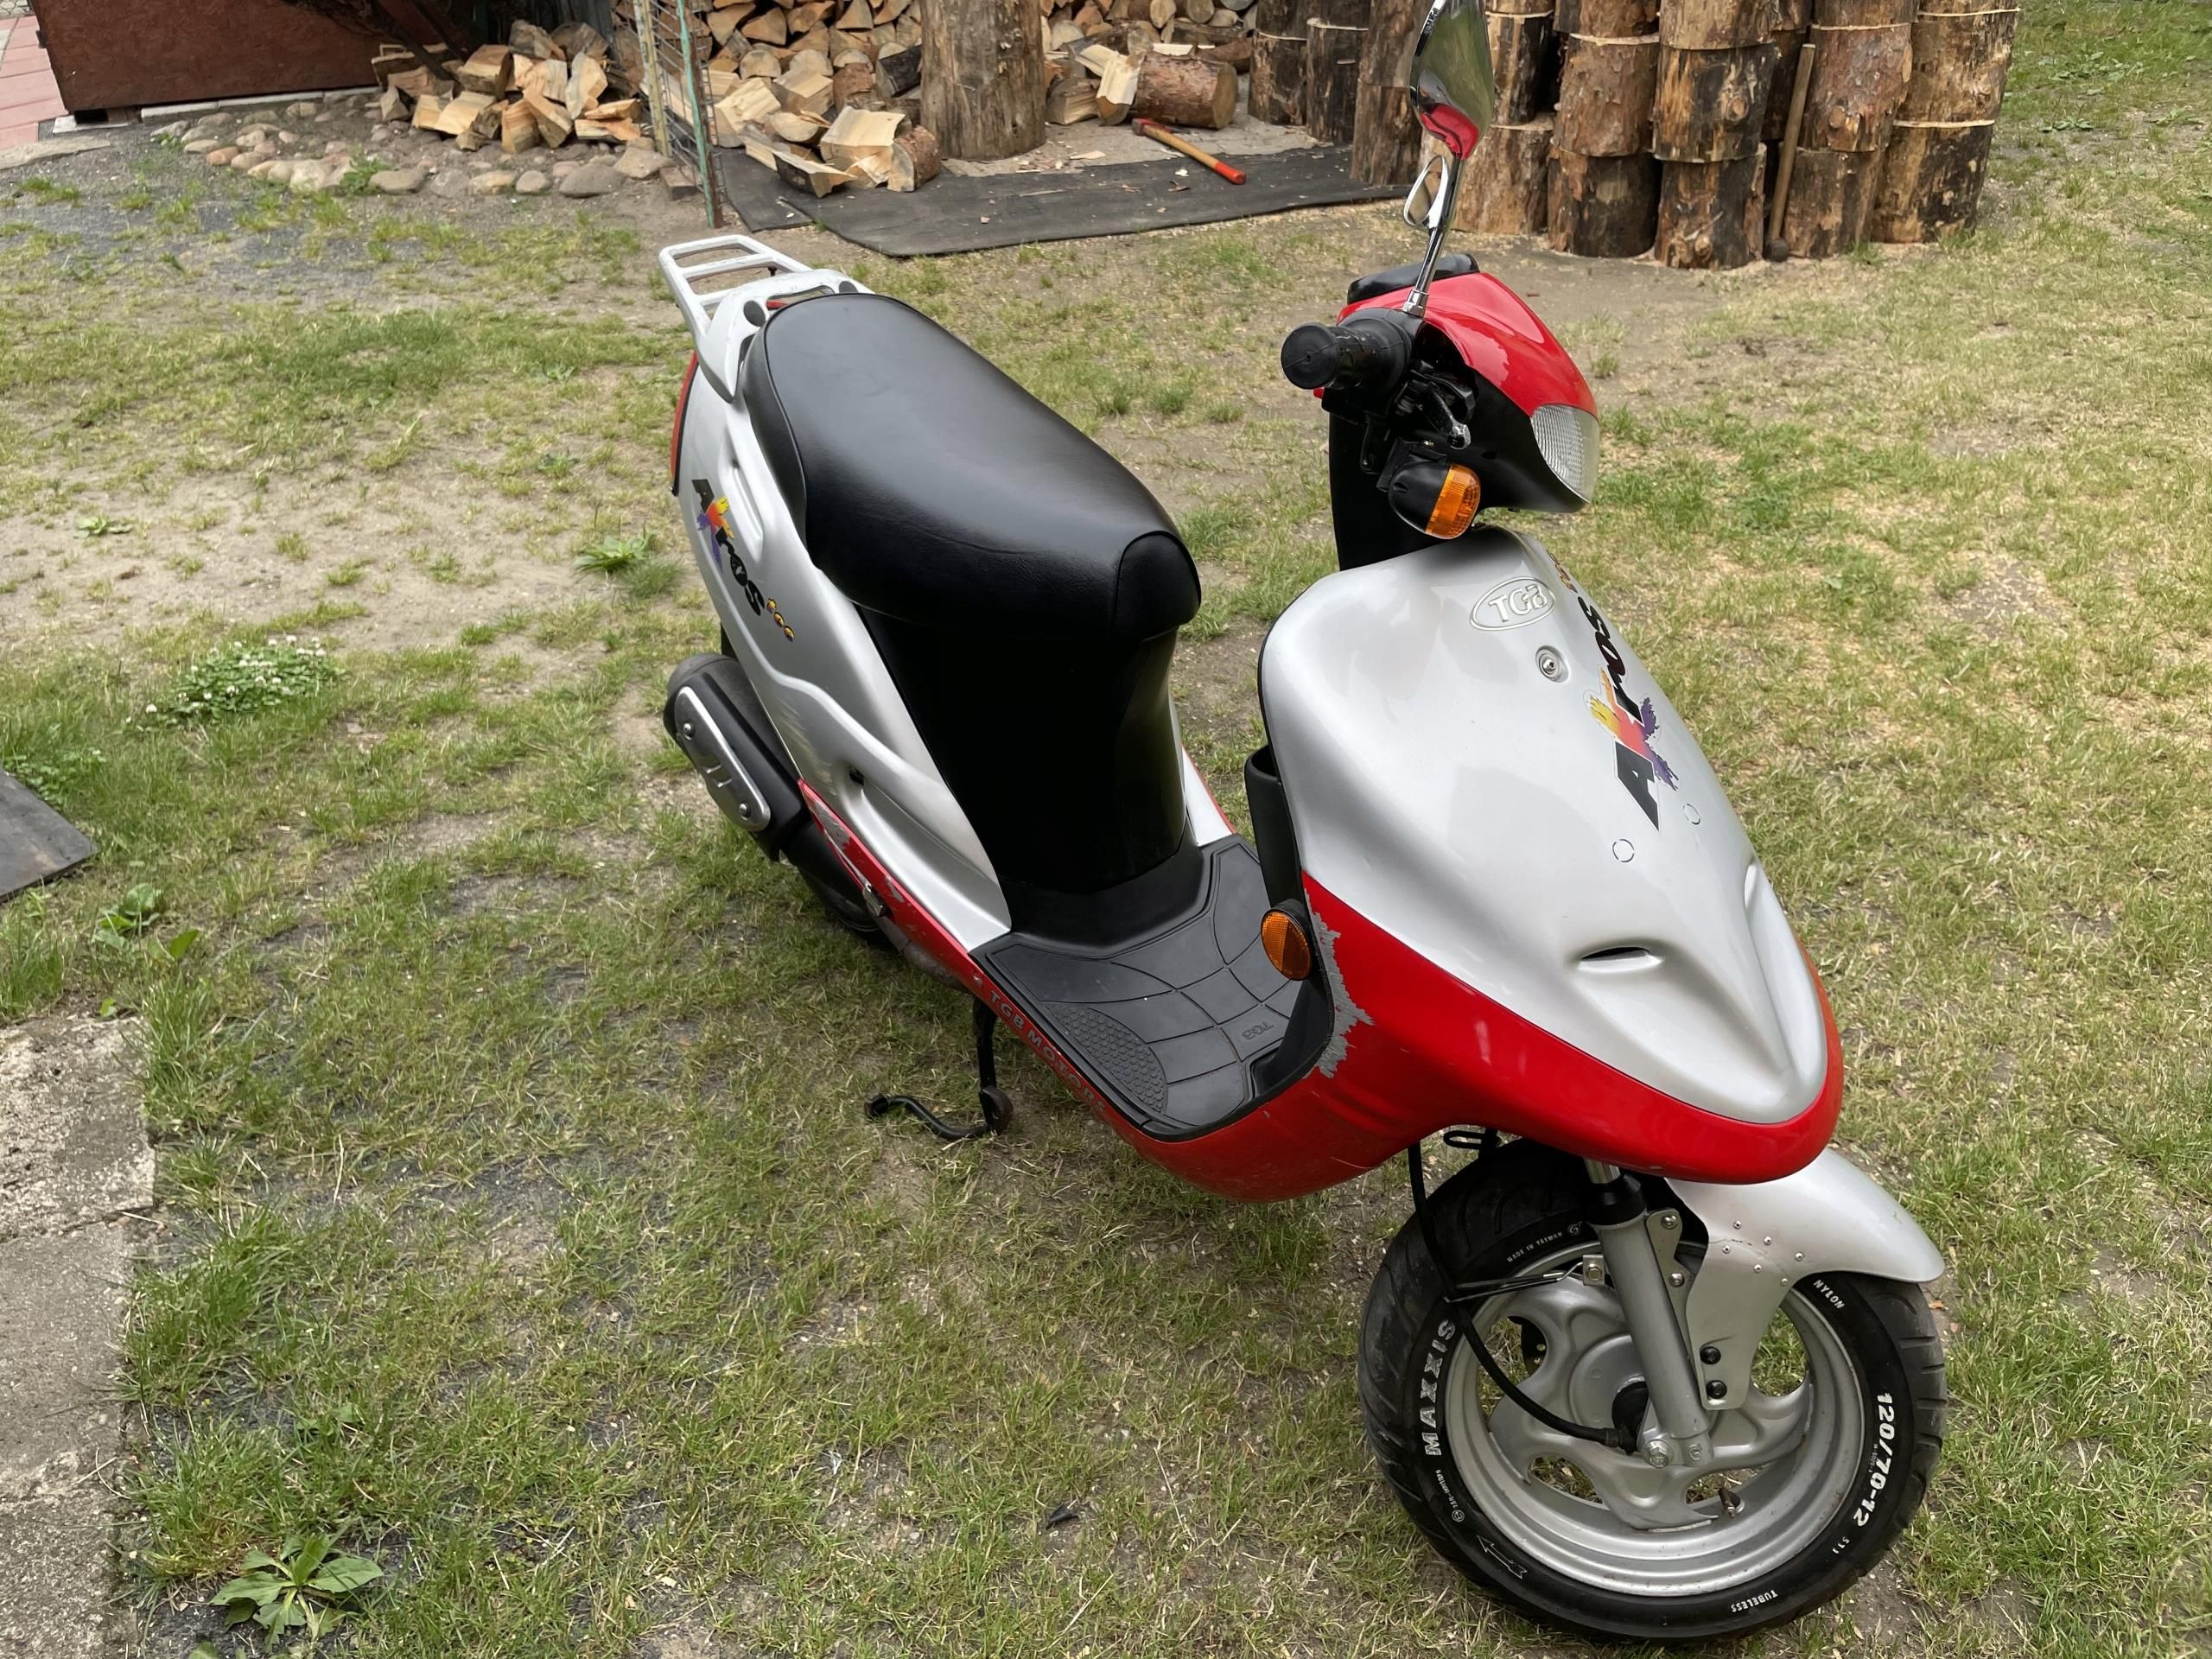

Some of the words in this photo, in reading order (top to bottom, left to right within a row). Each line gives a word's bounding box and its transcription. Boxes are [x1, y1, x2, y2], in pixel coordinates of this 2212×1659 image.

[1487, 584, 1548, 622] TGB
[989, 990, 1025, 1029] TGB
[1028, 1028, 1107, 1114] MOTORS
[1507, 1247, 1527, 1262] MADE
[1535, 1231, 1563, 1247] TAIWAN
[1812, 1279, 1845, 1310] NYLON
[1420, 1319, 1456, 1457] MAXXIS
[1851, 1391, 1896, 1528] 120/70-12
[1729, 1589, 1778, 1612] TUBELESS
